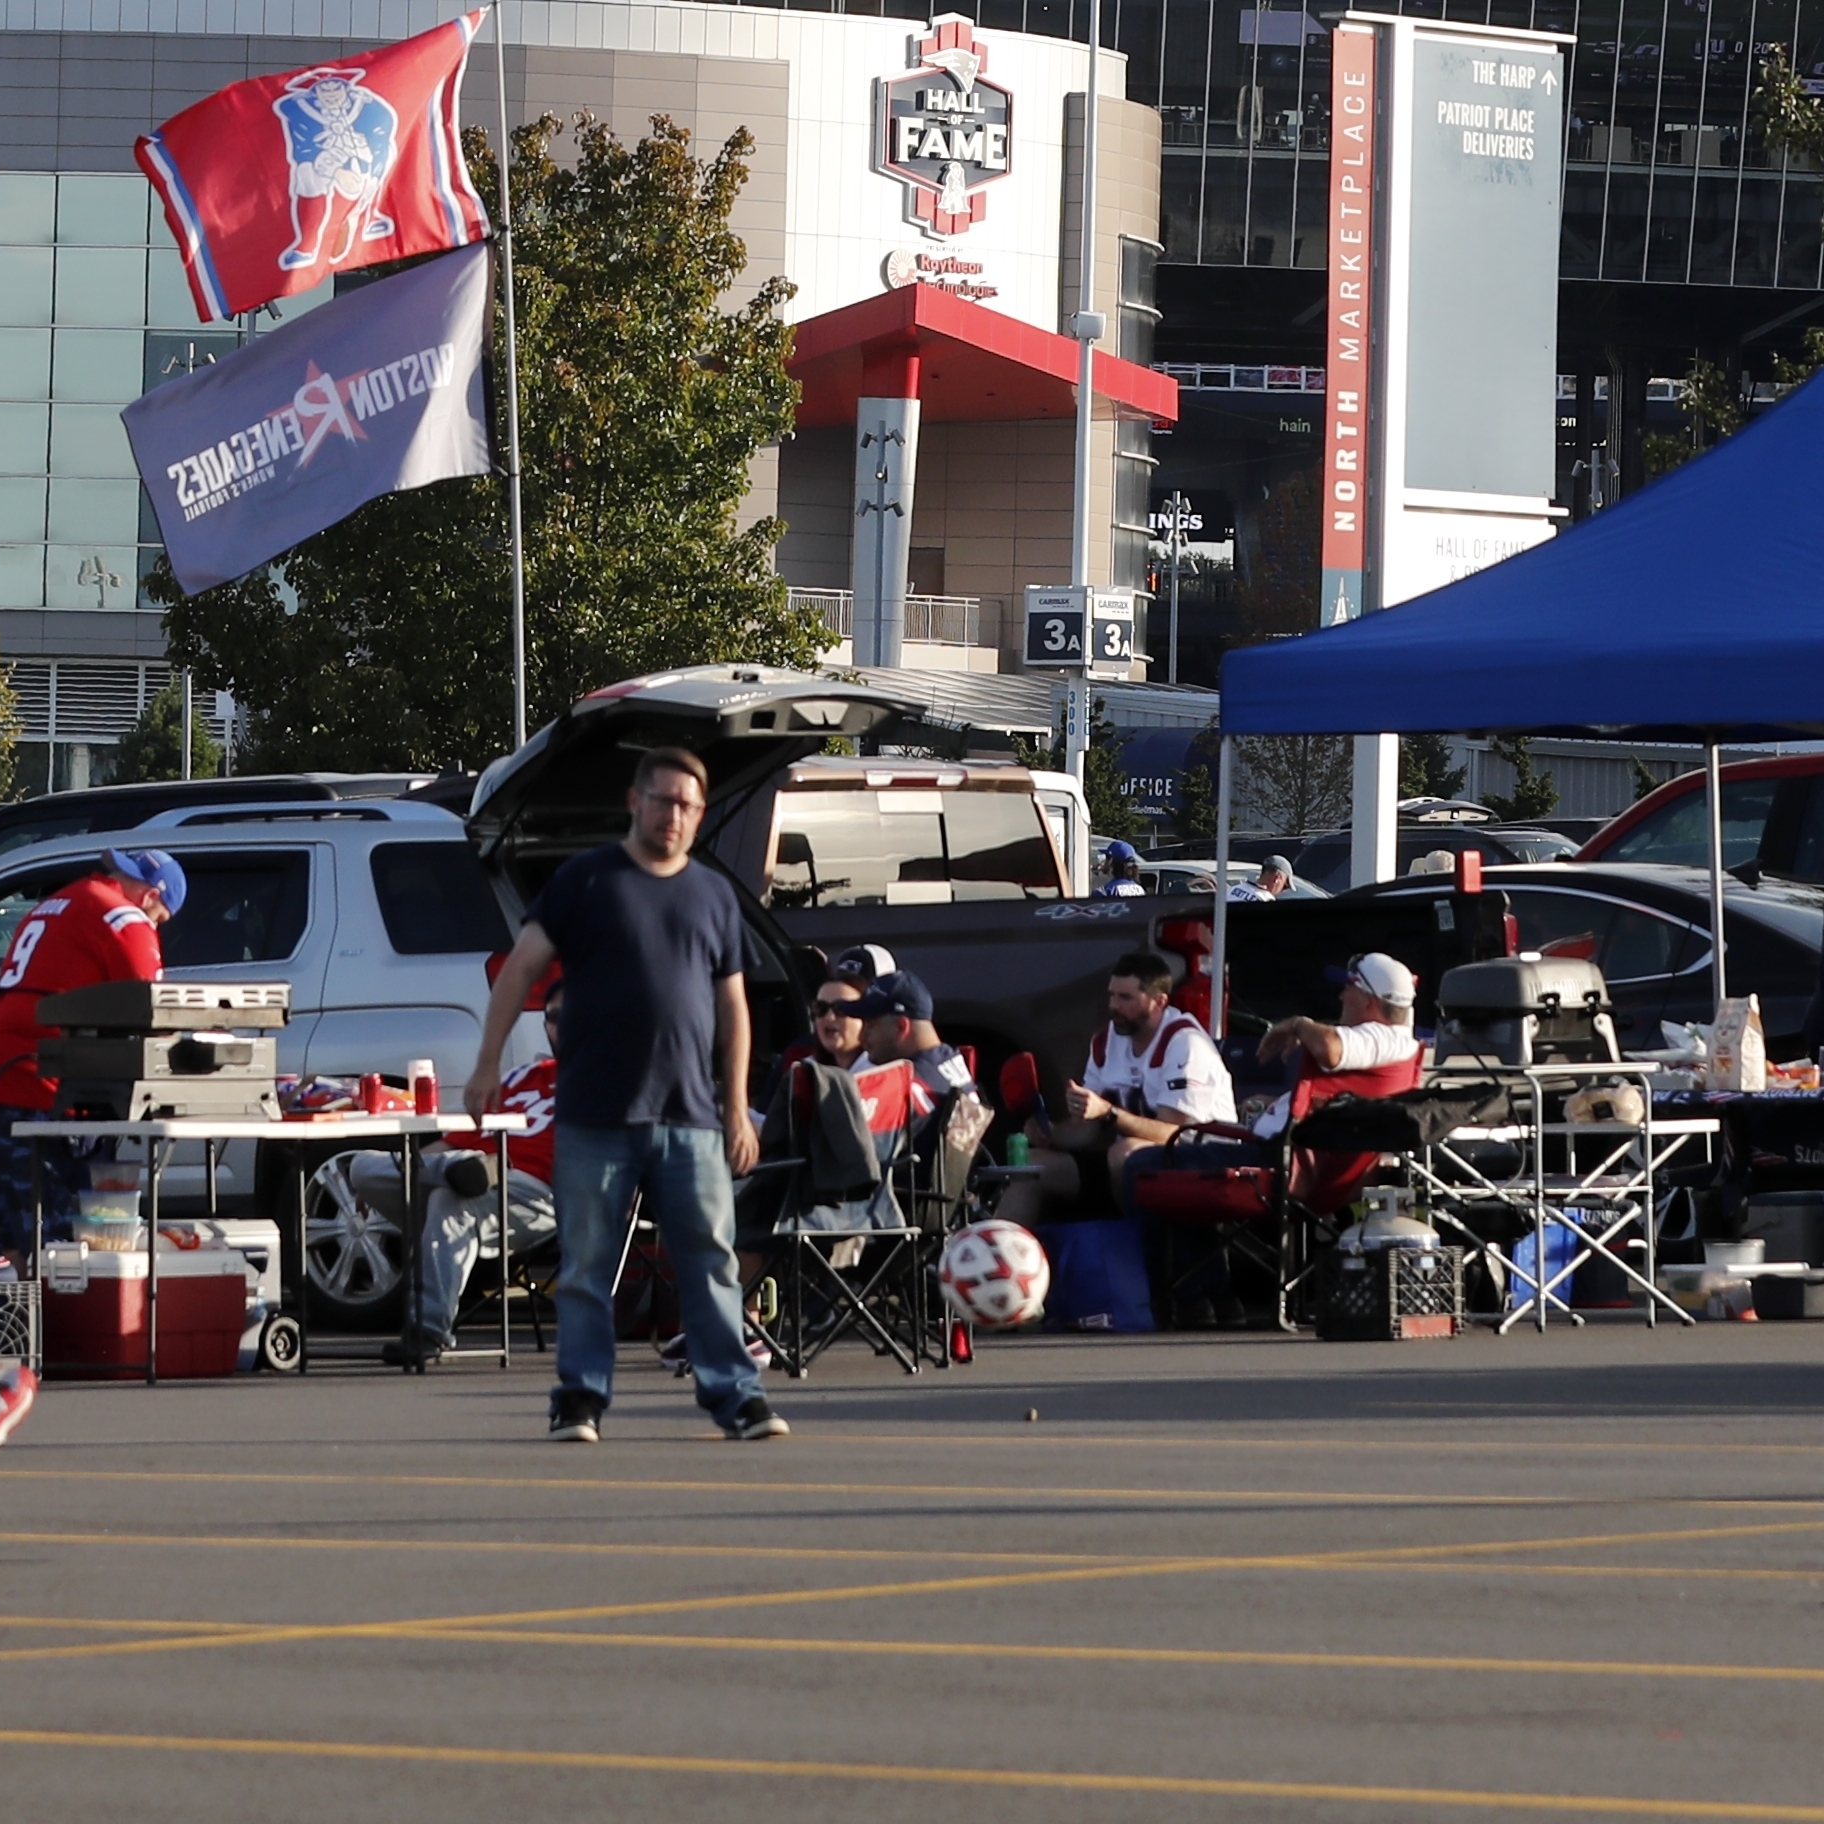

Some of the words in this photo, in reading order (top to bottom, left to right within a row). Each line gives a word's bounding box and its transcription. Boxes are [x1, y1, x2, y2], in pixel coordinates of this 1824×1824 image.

[1472, 60, 1497, 86] THE
[1500, 65, 1536, 89] HARP
[927, 88, 985, 114] HALL
[1438, 100, 1492, 129] PATRIOT
[1495, 109, 1535, 134] PLACE
[950, 114, 964, 125] OF
[897, 116, 1007, 170] FAME
[1462, 130, 1535, 161] DELIVERIES
[1339, 70, 1366, 362] MARKETPLACE
[918, 254, 983, 274] Raytheon
[1334, 390, 1359, 531] NORTH
[1435, 537, 1467, 559] HALL
[1474, 539, 1488, 559] OF
[1068, 692, 1076, 736] 300
[0, 919, 45, 988] 9
